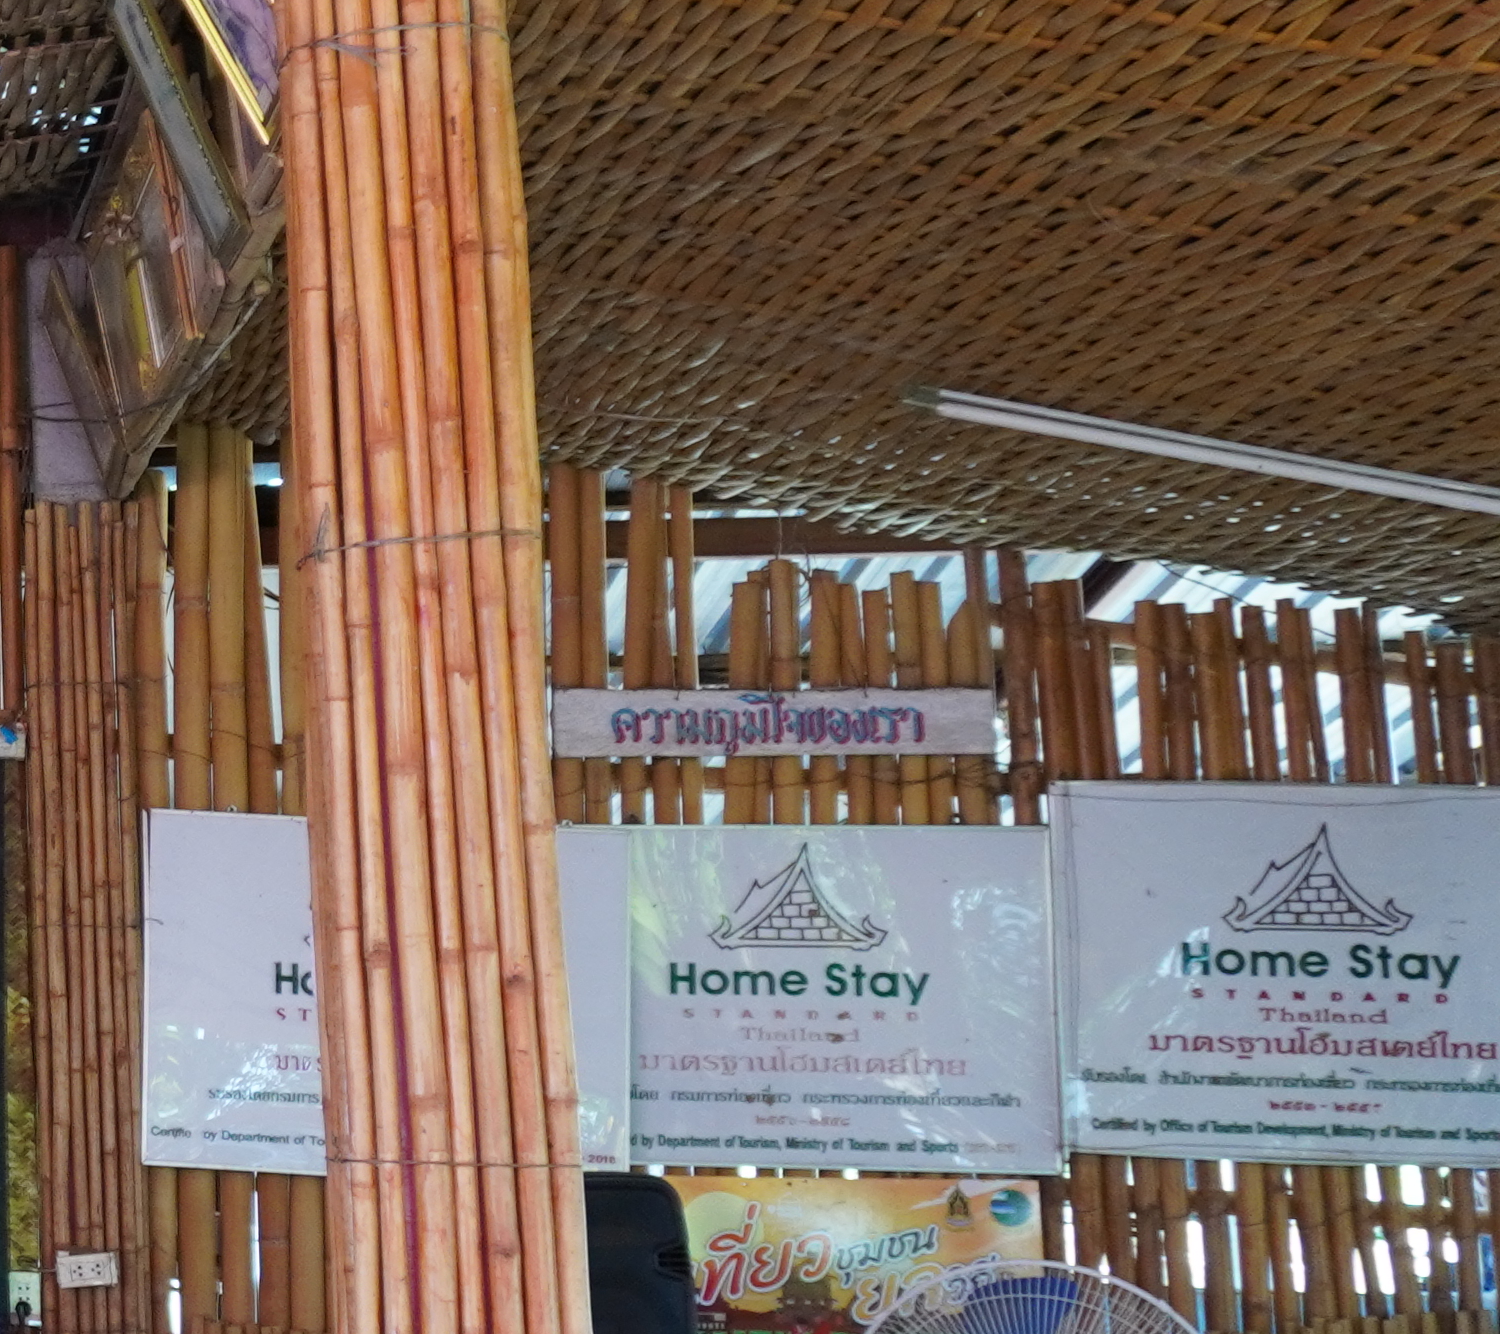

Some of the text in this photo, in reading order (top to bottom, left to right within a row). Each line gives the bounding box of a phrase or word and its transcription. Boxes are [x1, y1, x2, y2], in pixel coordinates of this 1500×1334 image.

[1180, 940, 1461, 989] Home Stay
[668, 962, 930, 1006] Home Stay
[1192, 987, 1449, 1004] STANDARD
[683, 1007, 920, 1021] STANDARD
[1259, 1007, 1389, 1024] Thailand
[221, 1129, 290, 1145] Department
[294, 1133, 306, 1145] of
[641, 1134, 654, 1149] by
[657, 1134, 721, 1151] Department
[725, 1134, 737, 1148] of
[785, 1136, 828, 1153] Ministry
[831, 1138, 843, 1150] of
[848, 1138, 891, 1152] Tourism
[897, 1140, 917, 1152] and
[922, 1139, 959, 1155] Sports
